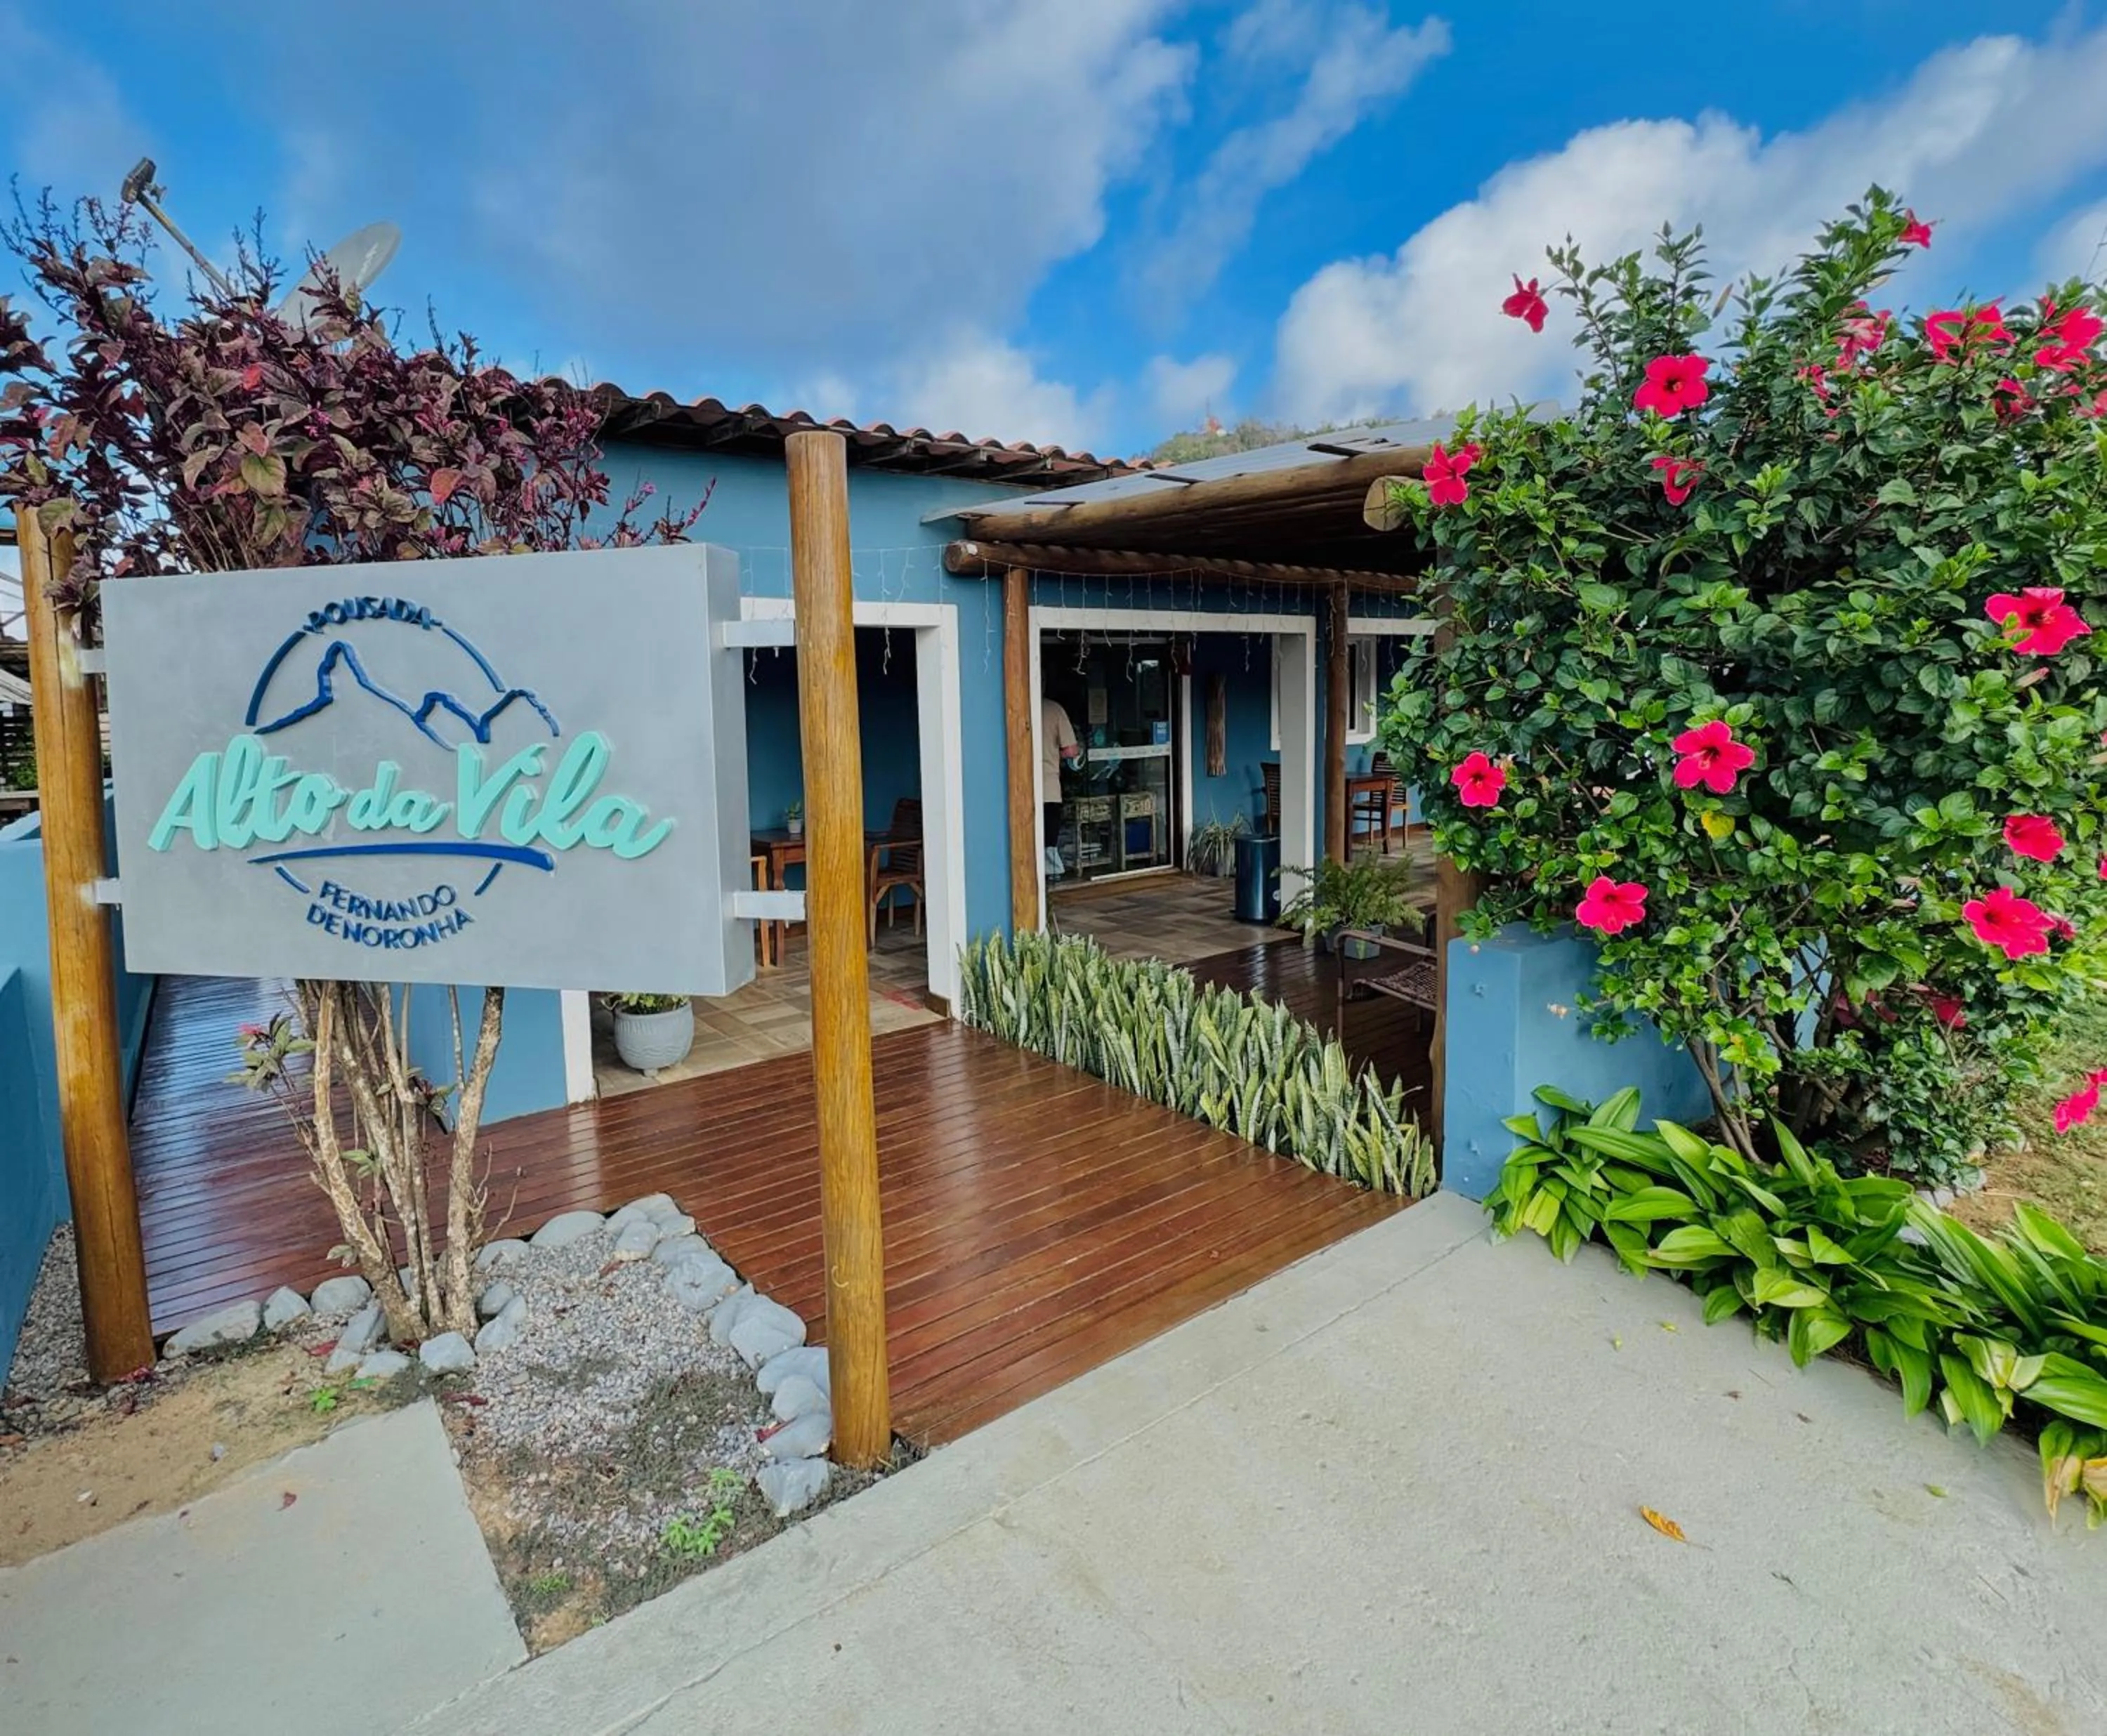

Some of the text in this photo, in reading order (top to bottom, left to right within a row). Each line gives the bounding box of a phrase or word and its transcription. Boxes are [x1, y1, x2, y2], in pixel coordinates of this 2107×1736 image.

[307, 596, 431, 633] POUSADA
[147, 731, 674, 860] Alto da Vila
[320, 879, 457, 922] FERNANDO
